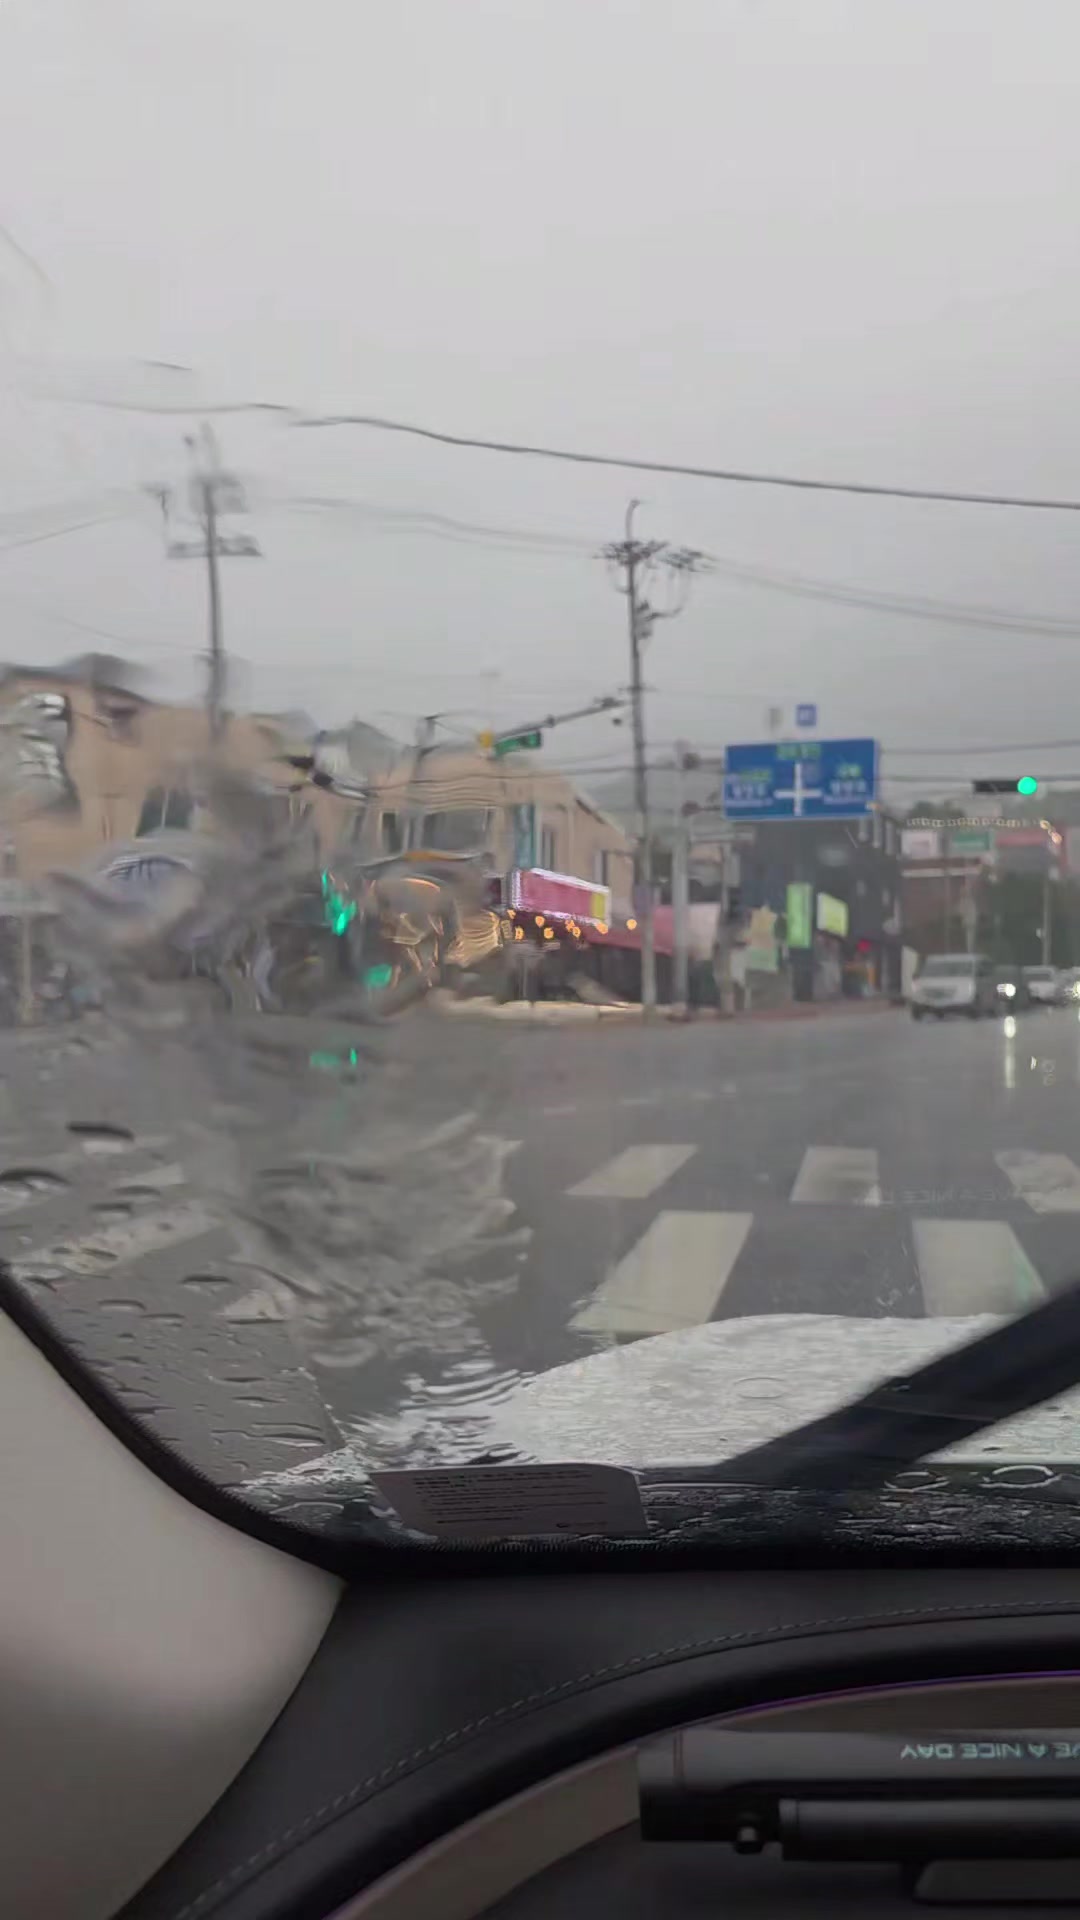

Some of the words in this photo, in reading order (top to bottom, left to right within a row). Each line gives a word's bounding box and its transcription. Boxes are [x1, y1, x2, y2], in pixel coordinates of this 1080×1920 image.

[900, 1743, 953, 1759] DAY
[960, 1743, 1021, 1759] NICE
[1028, 1743, 1048, 1757] A
